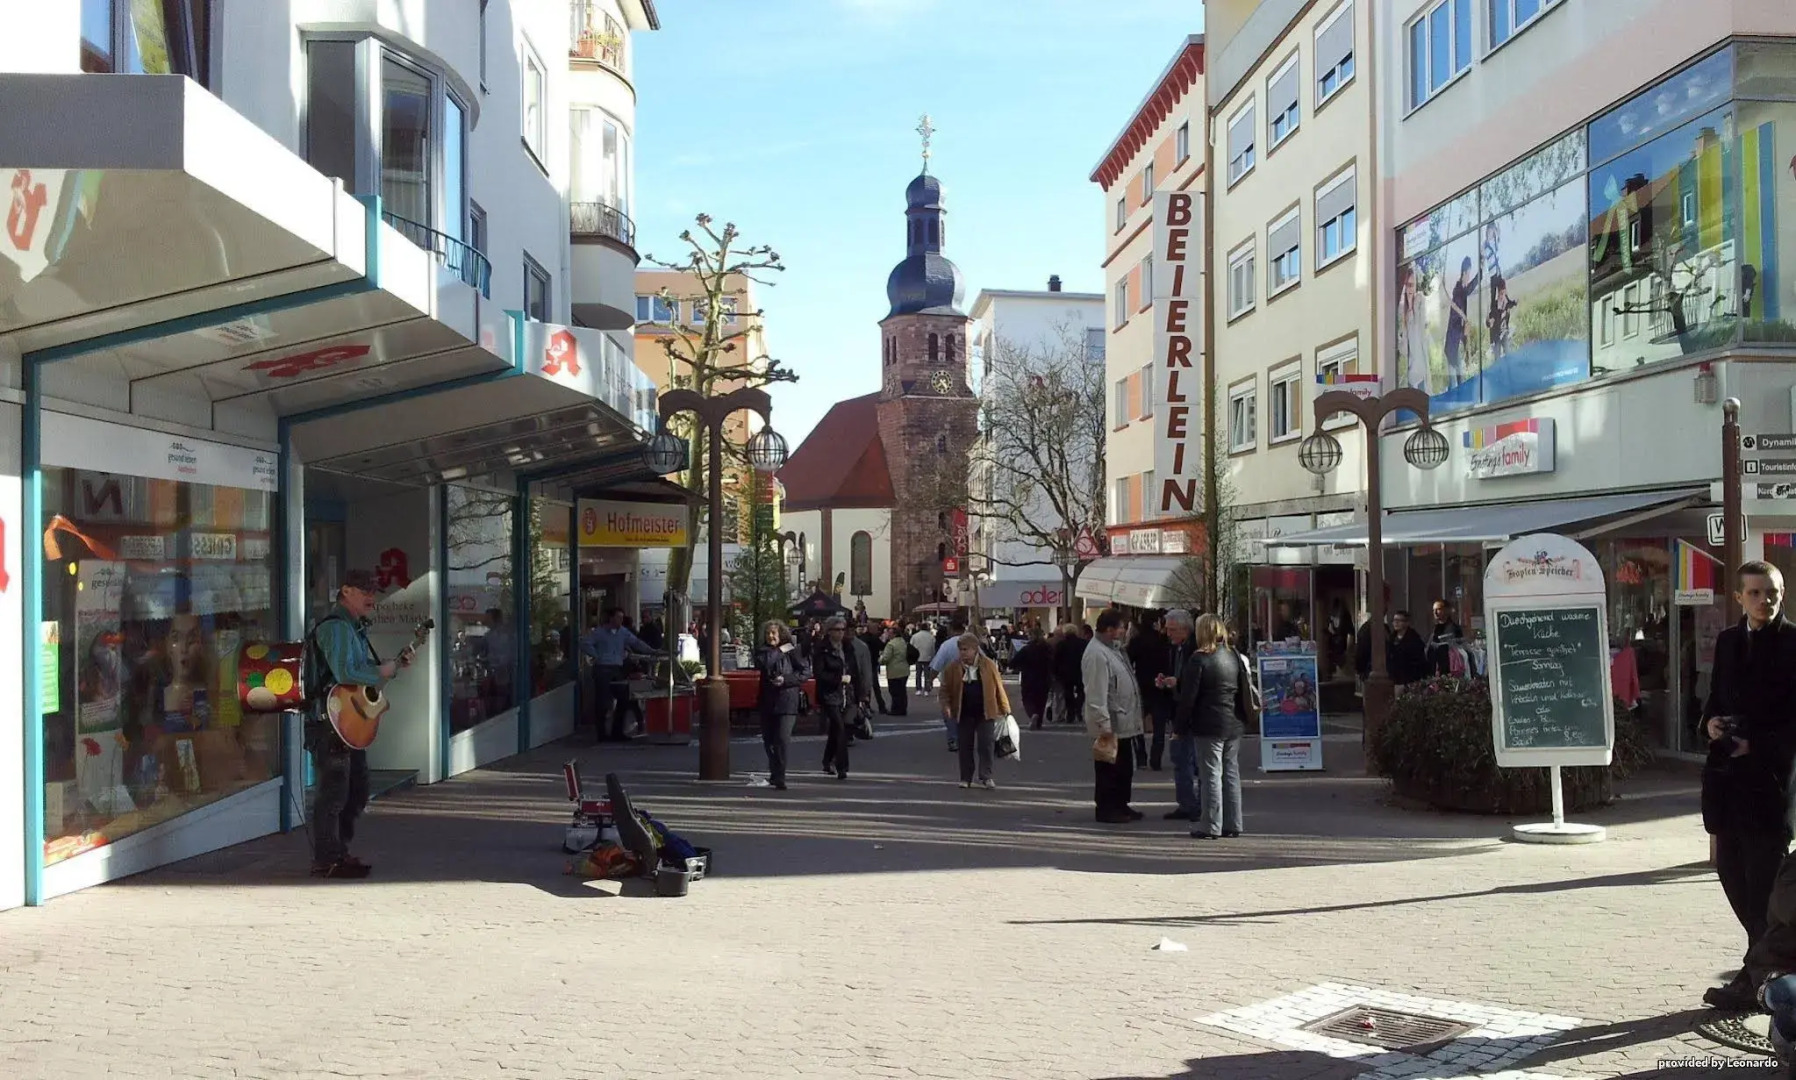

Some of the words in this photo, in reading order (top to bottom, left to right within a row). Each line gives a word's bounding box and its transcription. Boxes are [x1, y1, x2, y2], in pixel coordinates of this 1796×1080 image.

[1161, 193, 1197, 512] BEIERLEIN
[1502, 441, 1530, 467] family
[607, 512, 680, 534] Hofmeister
[1021, 585, 1064, 605] adler
